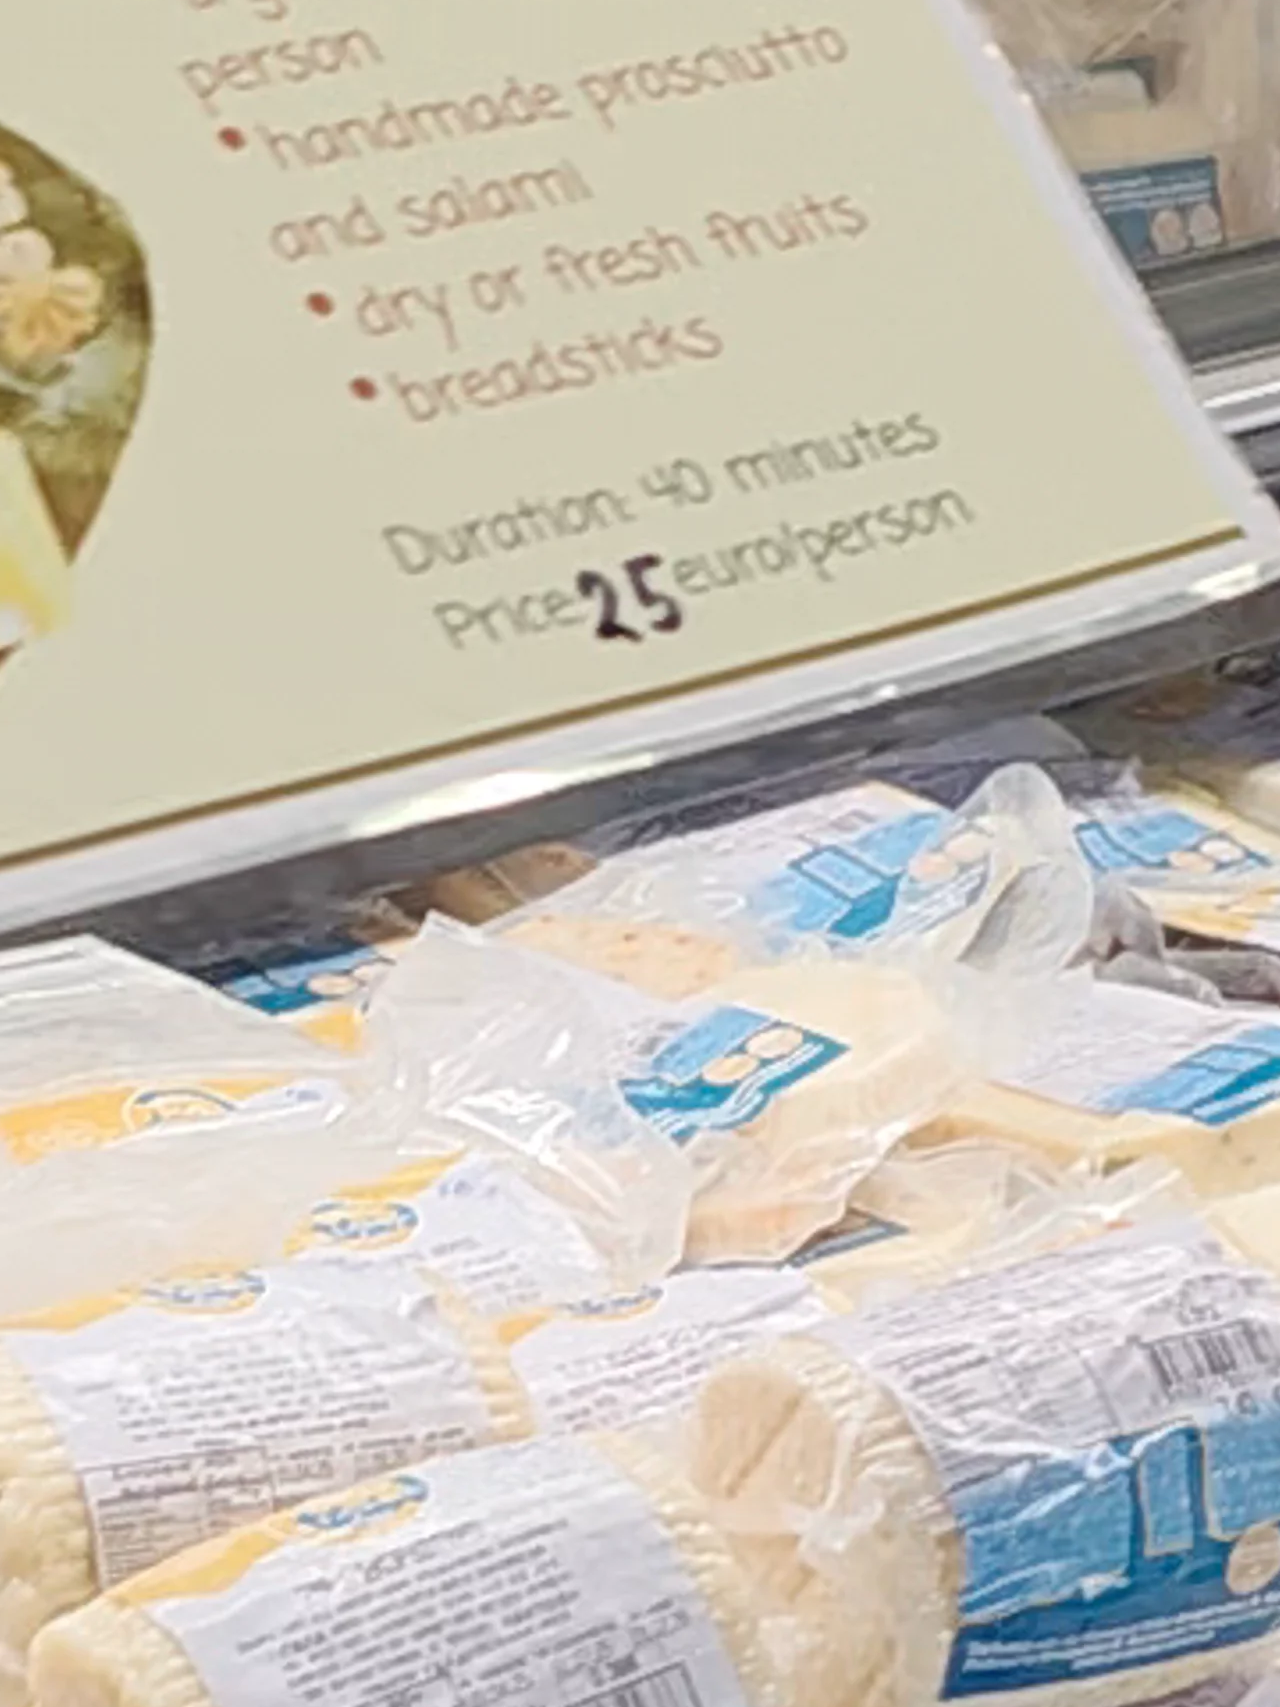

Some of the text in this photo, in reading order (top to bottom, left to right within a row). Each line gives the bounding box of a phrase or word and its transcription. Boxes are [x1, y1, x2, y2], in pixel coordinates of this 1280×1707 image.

[177, 25, 385, 120] person
[260, 20, 850, 174] handmade prosciutto
[270, 157, 596, 263] and salami
[353, 189, 871, 353] dry or fresh fruits
[388, 313, 724, 425] breadsticks
[638, 457, 712, 508] 40
[723, 411, 939, 497] minutes
[575, 553, 682, 644] 25
